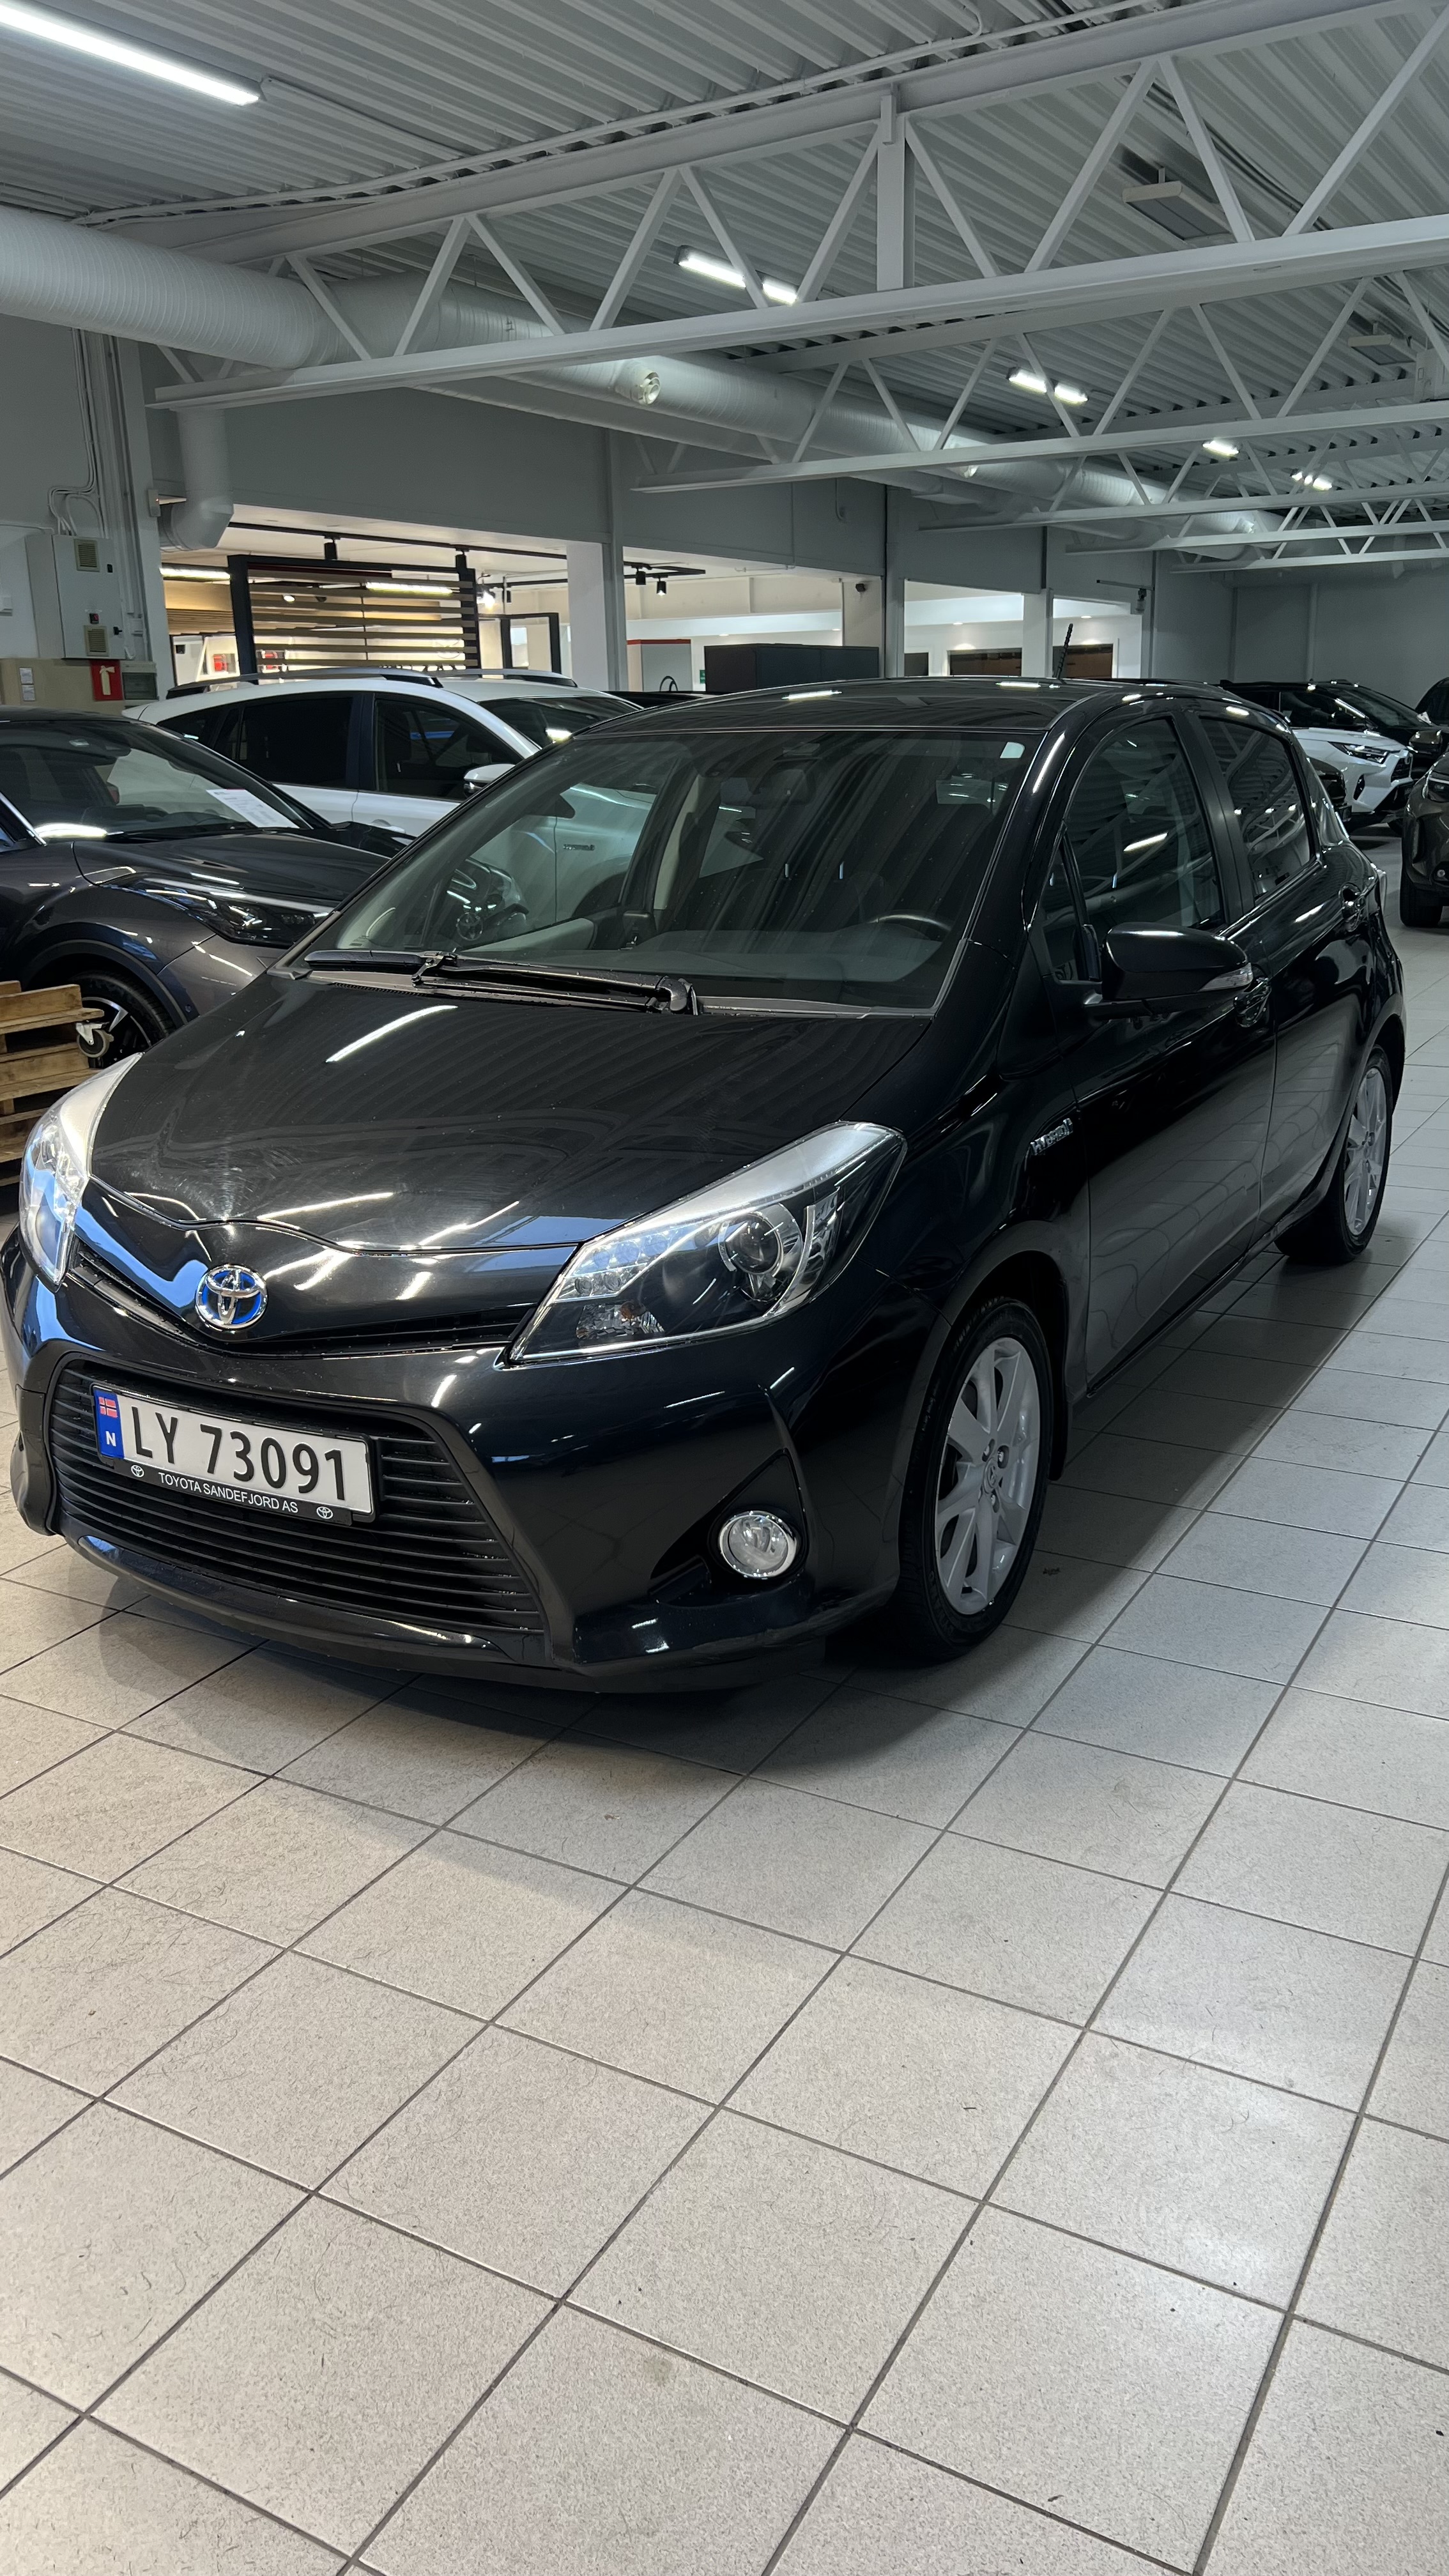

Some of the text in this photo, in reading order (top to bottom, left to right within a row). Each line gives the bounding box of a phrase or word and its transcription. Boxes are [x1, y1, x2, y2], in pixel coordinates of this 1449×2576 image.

[105, 1430, 116, 1446] N
[132, 1406, 345, 1501] LY 73091
[158, 1471, 299, 1514] TOYOTA SANDEFJORD AS
